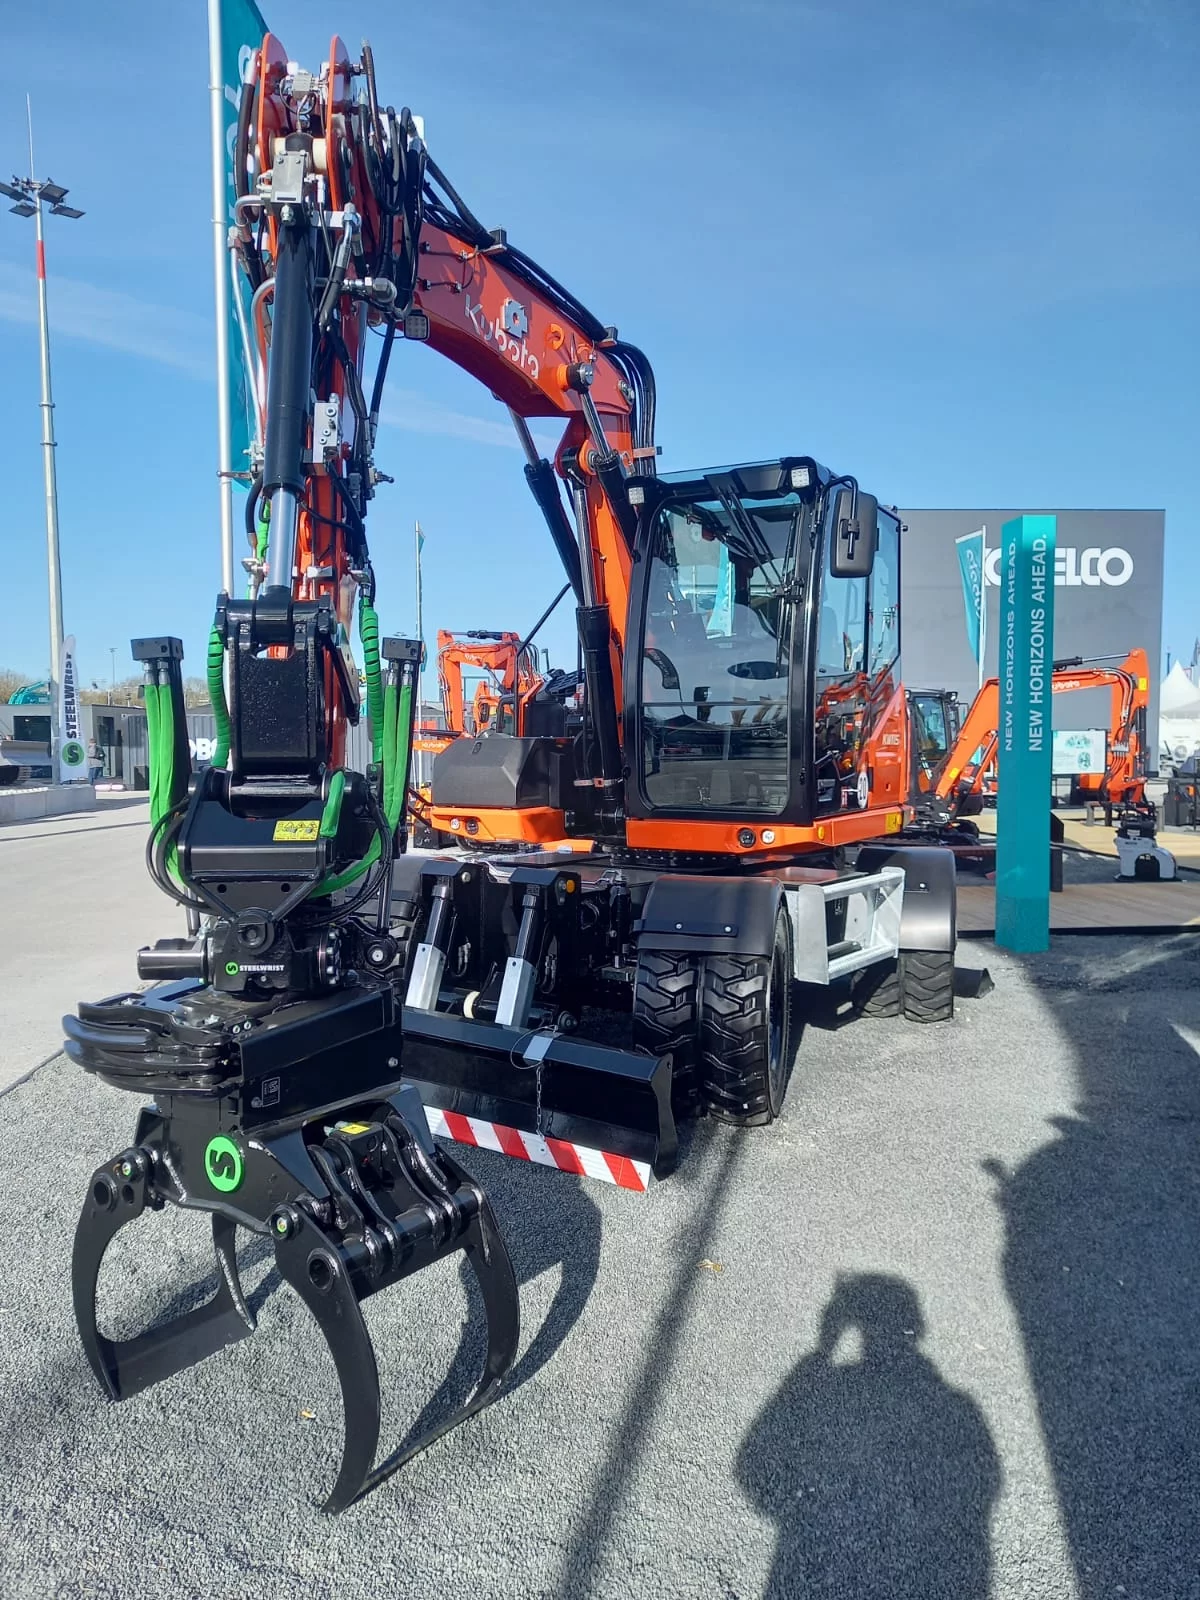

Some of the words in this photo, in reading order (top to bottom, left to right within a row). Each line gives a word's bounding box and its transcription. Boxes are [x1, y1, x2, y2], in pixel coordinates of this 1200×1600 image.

[1007, 537, 1017, 605] AHEAD.
[1031, 534, 1048, 603] AHEAD.
[1006, 610, 1015, 705] HORIZONS
[1029, 607, 1045, 704] HORIZONS
[63, 652, 77, 739] STEELWRIST
[1005, 711, 1013, 751] NEW
[1029, 710, 1043, 752] NEW
[239, 964, 285, 972] STEELWRIST
